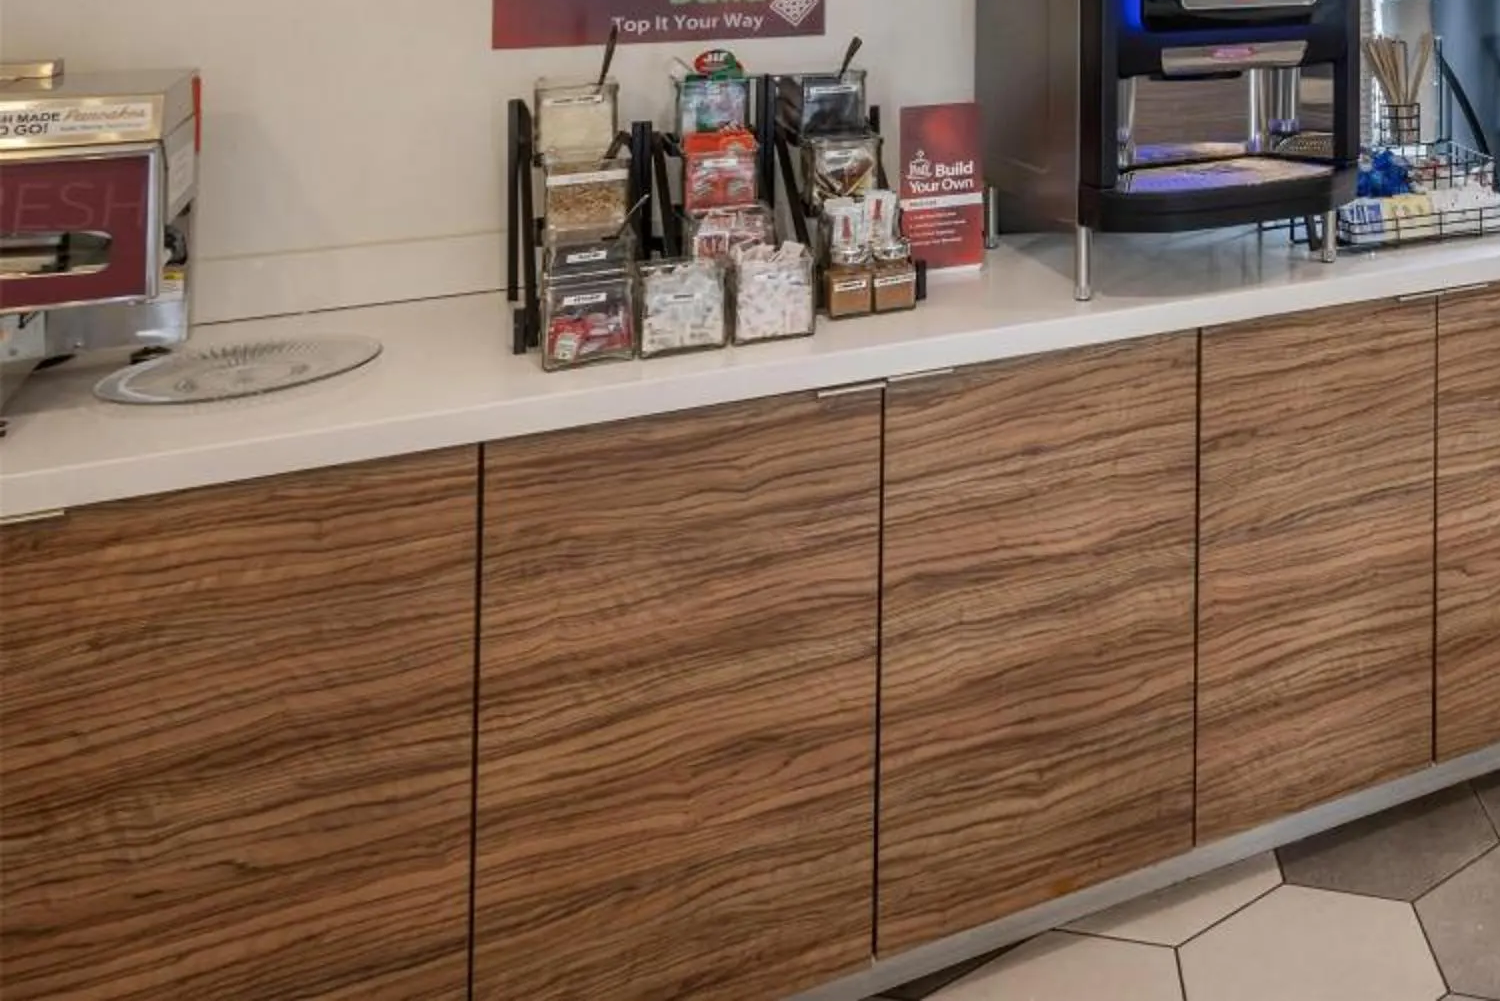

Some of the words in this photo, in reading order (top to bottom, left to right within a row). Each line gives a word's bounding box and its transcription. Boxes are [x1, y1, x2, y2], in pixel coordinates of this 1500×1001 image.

[610, 15, 651, 36] Top
[655, 14, 669, 31] It
[673, 13, 721, 31] Your
[723, 11, 765, 31] Way
[16, 111, 61, 123] MADE
[14, 122, 49, 136] GO!
[935, 160, 975, 178] Build
[909, 180, 940, 194] Your
[941, 177, 974, 191] Own
